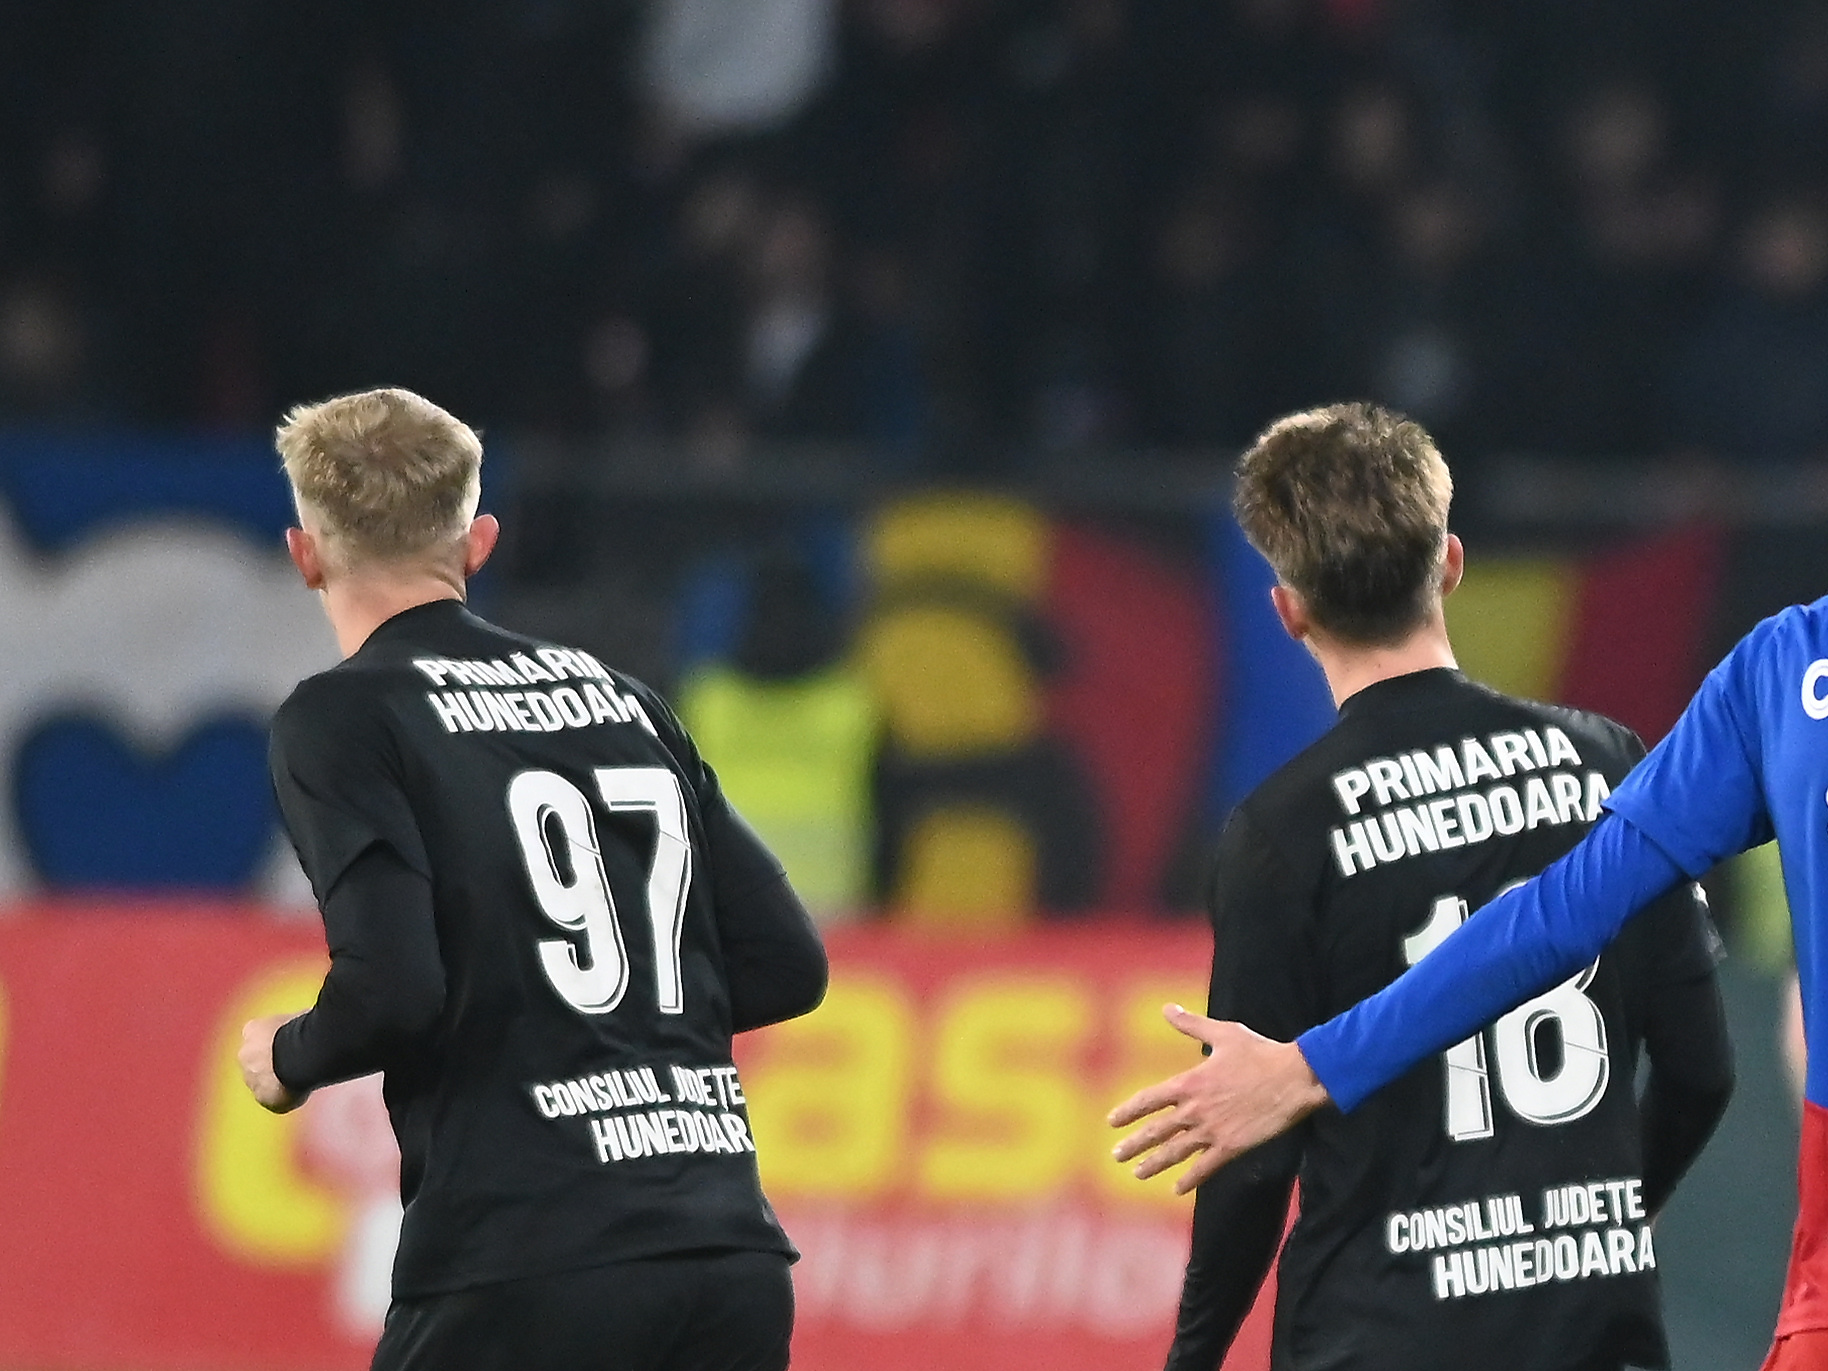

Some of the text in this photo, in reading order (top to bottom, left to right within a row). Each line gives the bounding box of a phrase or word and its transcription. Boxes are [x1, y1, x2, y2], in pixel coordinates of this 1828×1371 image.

[1334, 727, 1582, 815] PRIMĂRIA
[1333, 773, 1613, 877] HUNEDOARA
[509, 767, 693, 1015] 97
[1404, 876, 1610, 1141] 18
[533, 1065, 671, 1119] CONSILIUL
[590, 1109, 757, 1163] HUNEDOAR
[1389, 1195, 1534, 1254] CONSILIUL
[1434, 1226, 1657, 1299] HUNEDOARA
